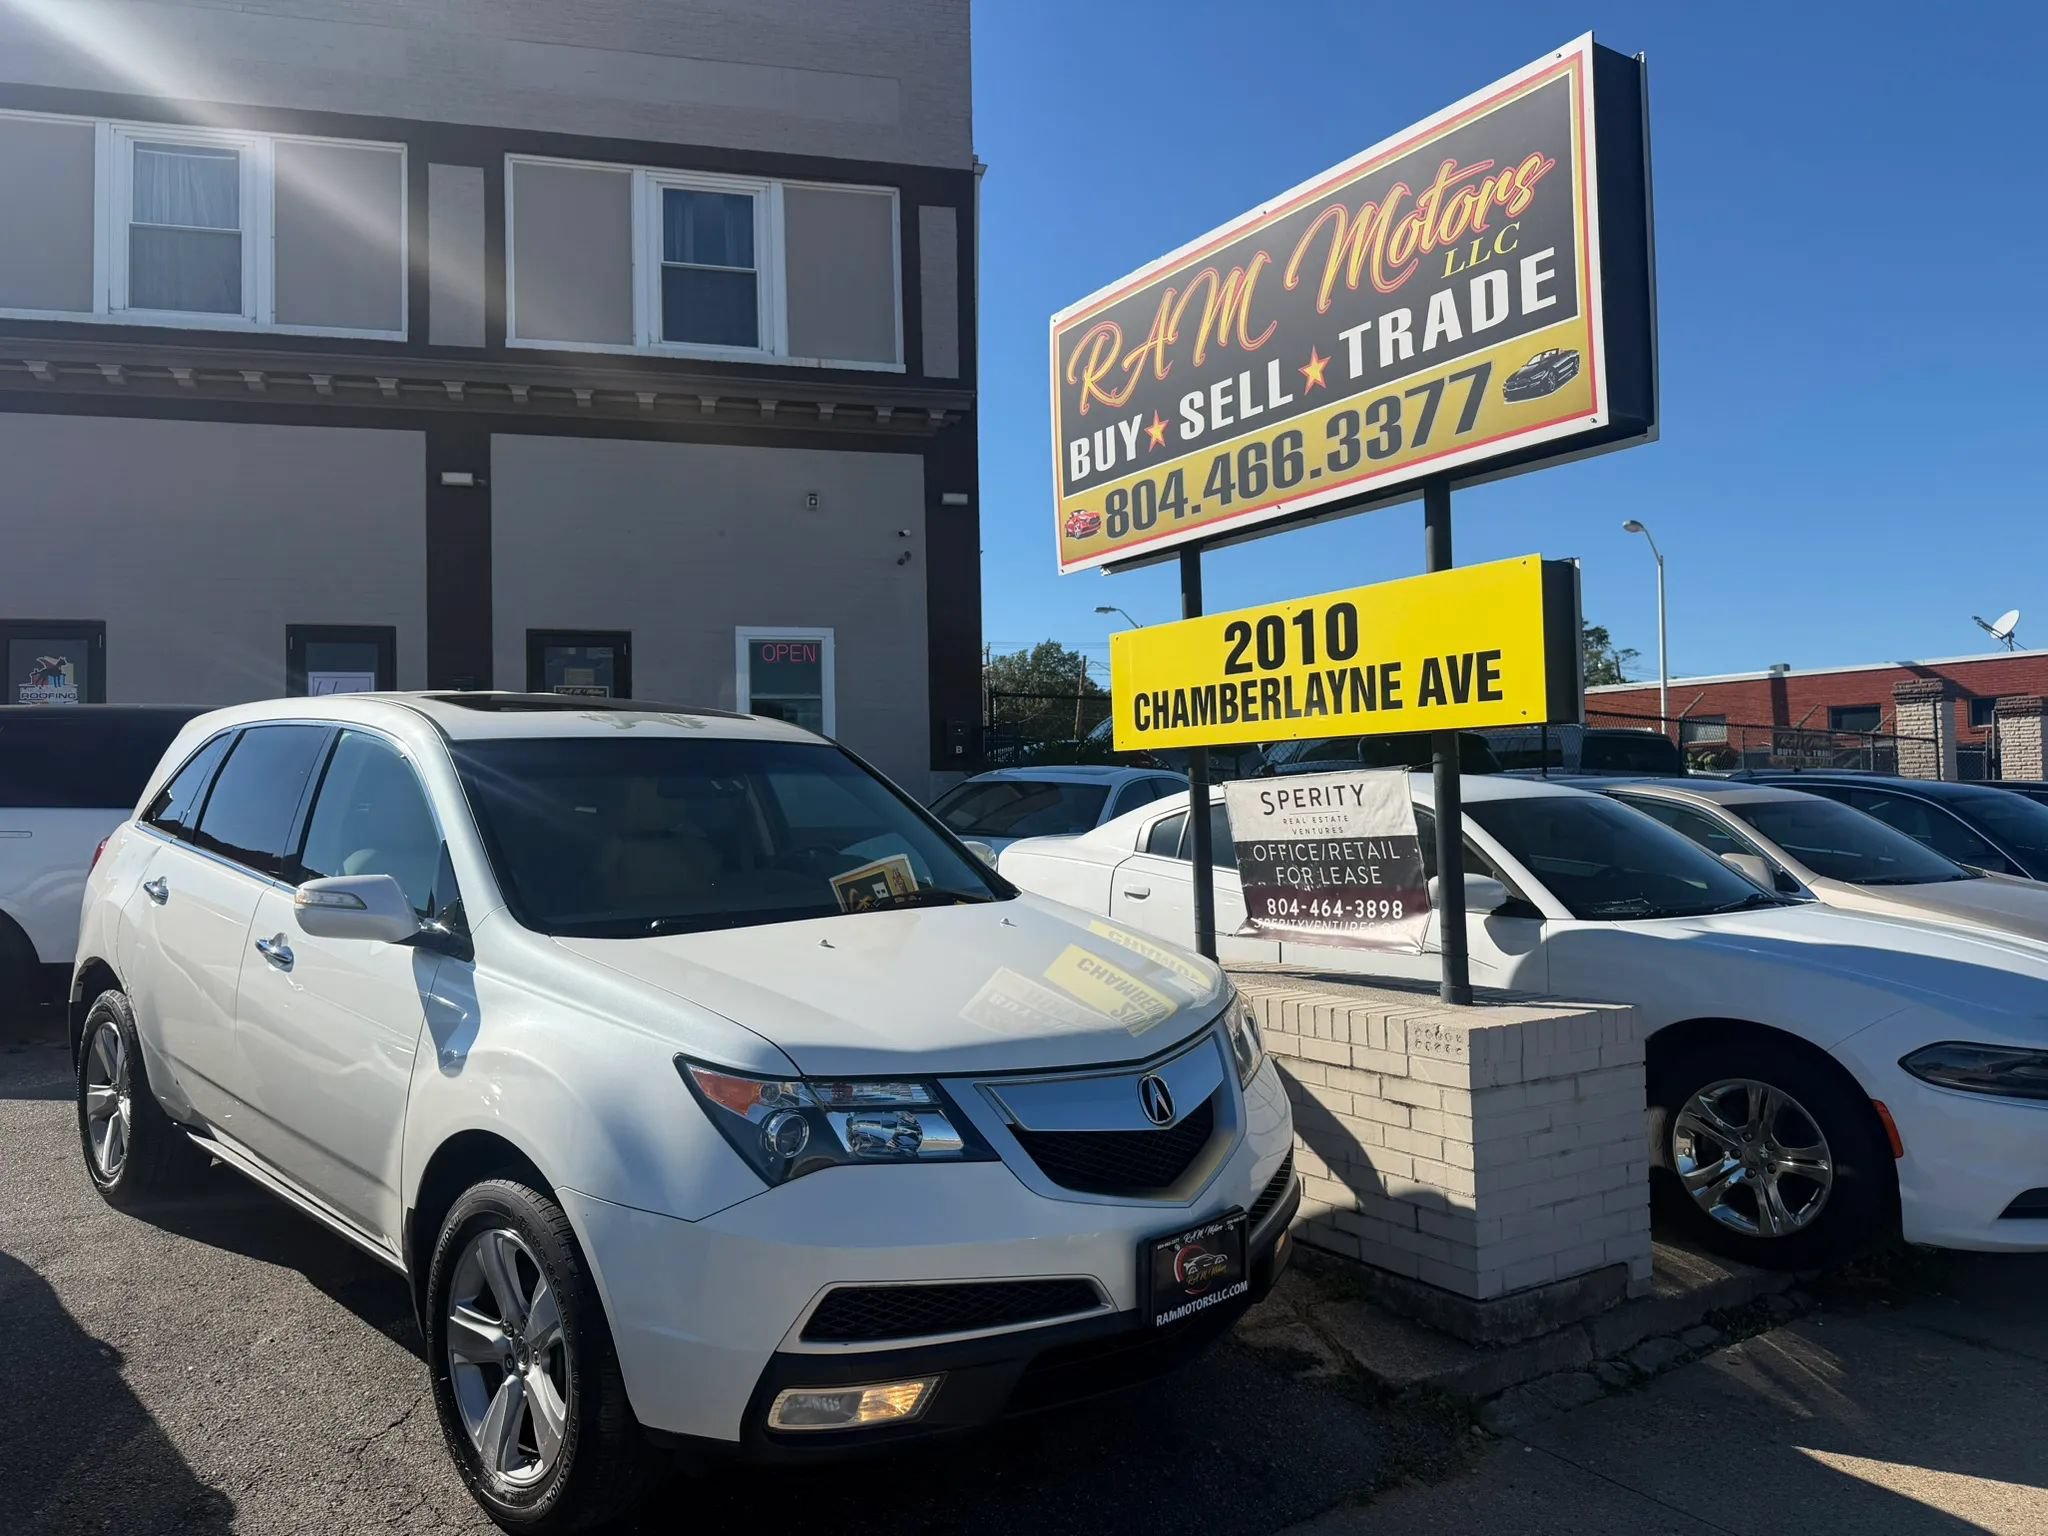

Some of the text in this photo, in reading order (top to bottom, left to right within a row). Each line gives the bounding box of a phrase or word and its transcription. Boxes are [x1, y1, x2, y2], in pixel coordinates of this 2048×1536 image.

[1441, 221, 1521, 279] LLC
[1066, 151, 1555, 415] RAM Motors
[1070, 247, 1557, 481] BUY SELL TRADE
[1105, 362, 1496, 538] 804.466.3377
[762, 643, 816, 663] OPEN
[1223, 601, 1359, 675] 2010
[20, 692, 77, 700] ROOFING
[1134, 650, 1503, 732] CHAMBERLAYNE AVE
[1260, 784, 1365, 816] SPERITY
[1283, 814, 1349, 825] REAL ESTATE
[1291, 826, 1344, 836] VENTURES
[1253, 840, 1401, 862] OFFICE/RETAIL
[1276, 866, 1383, 886] FOR LEASE
[1266, 898, 1404, 920] 804-464-3898
[1156, 1280, 1249, 1327] RAMMOTORSLLC.COM
